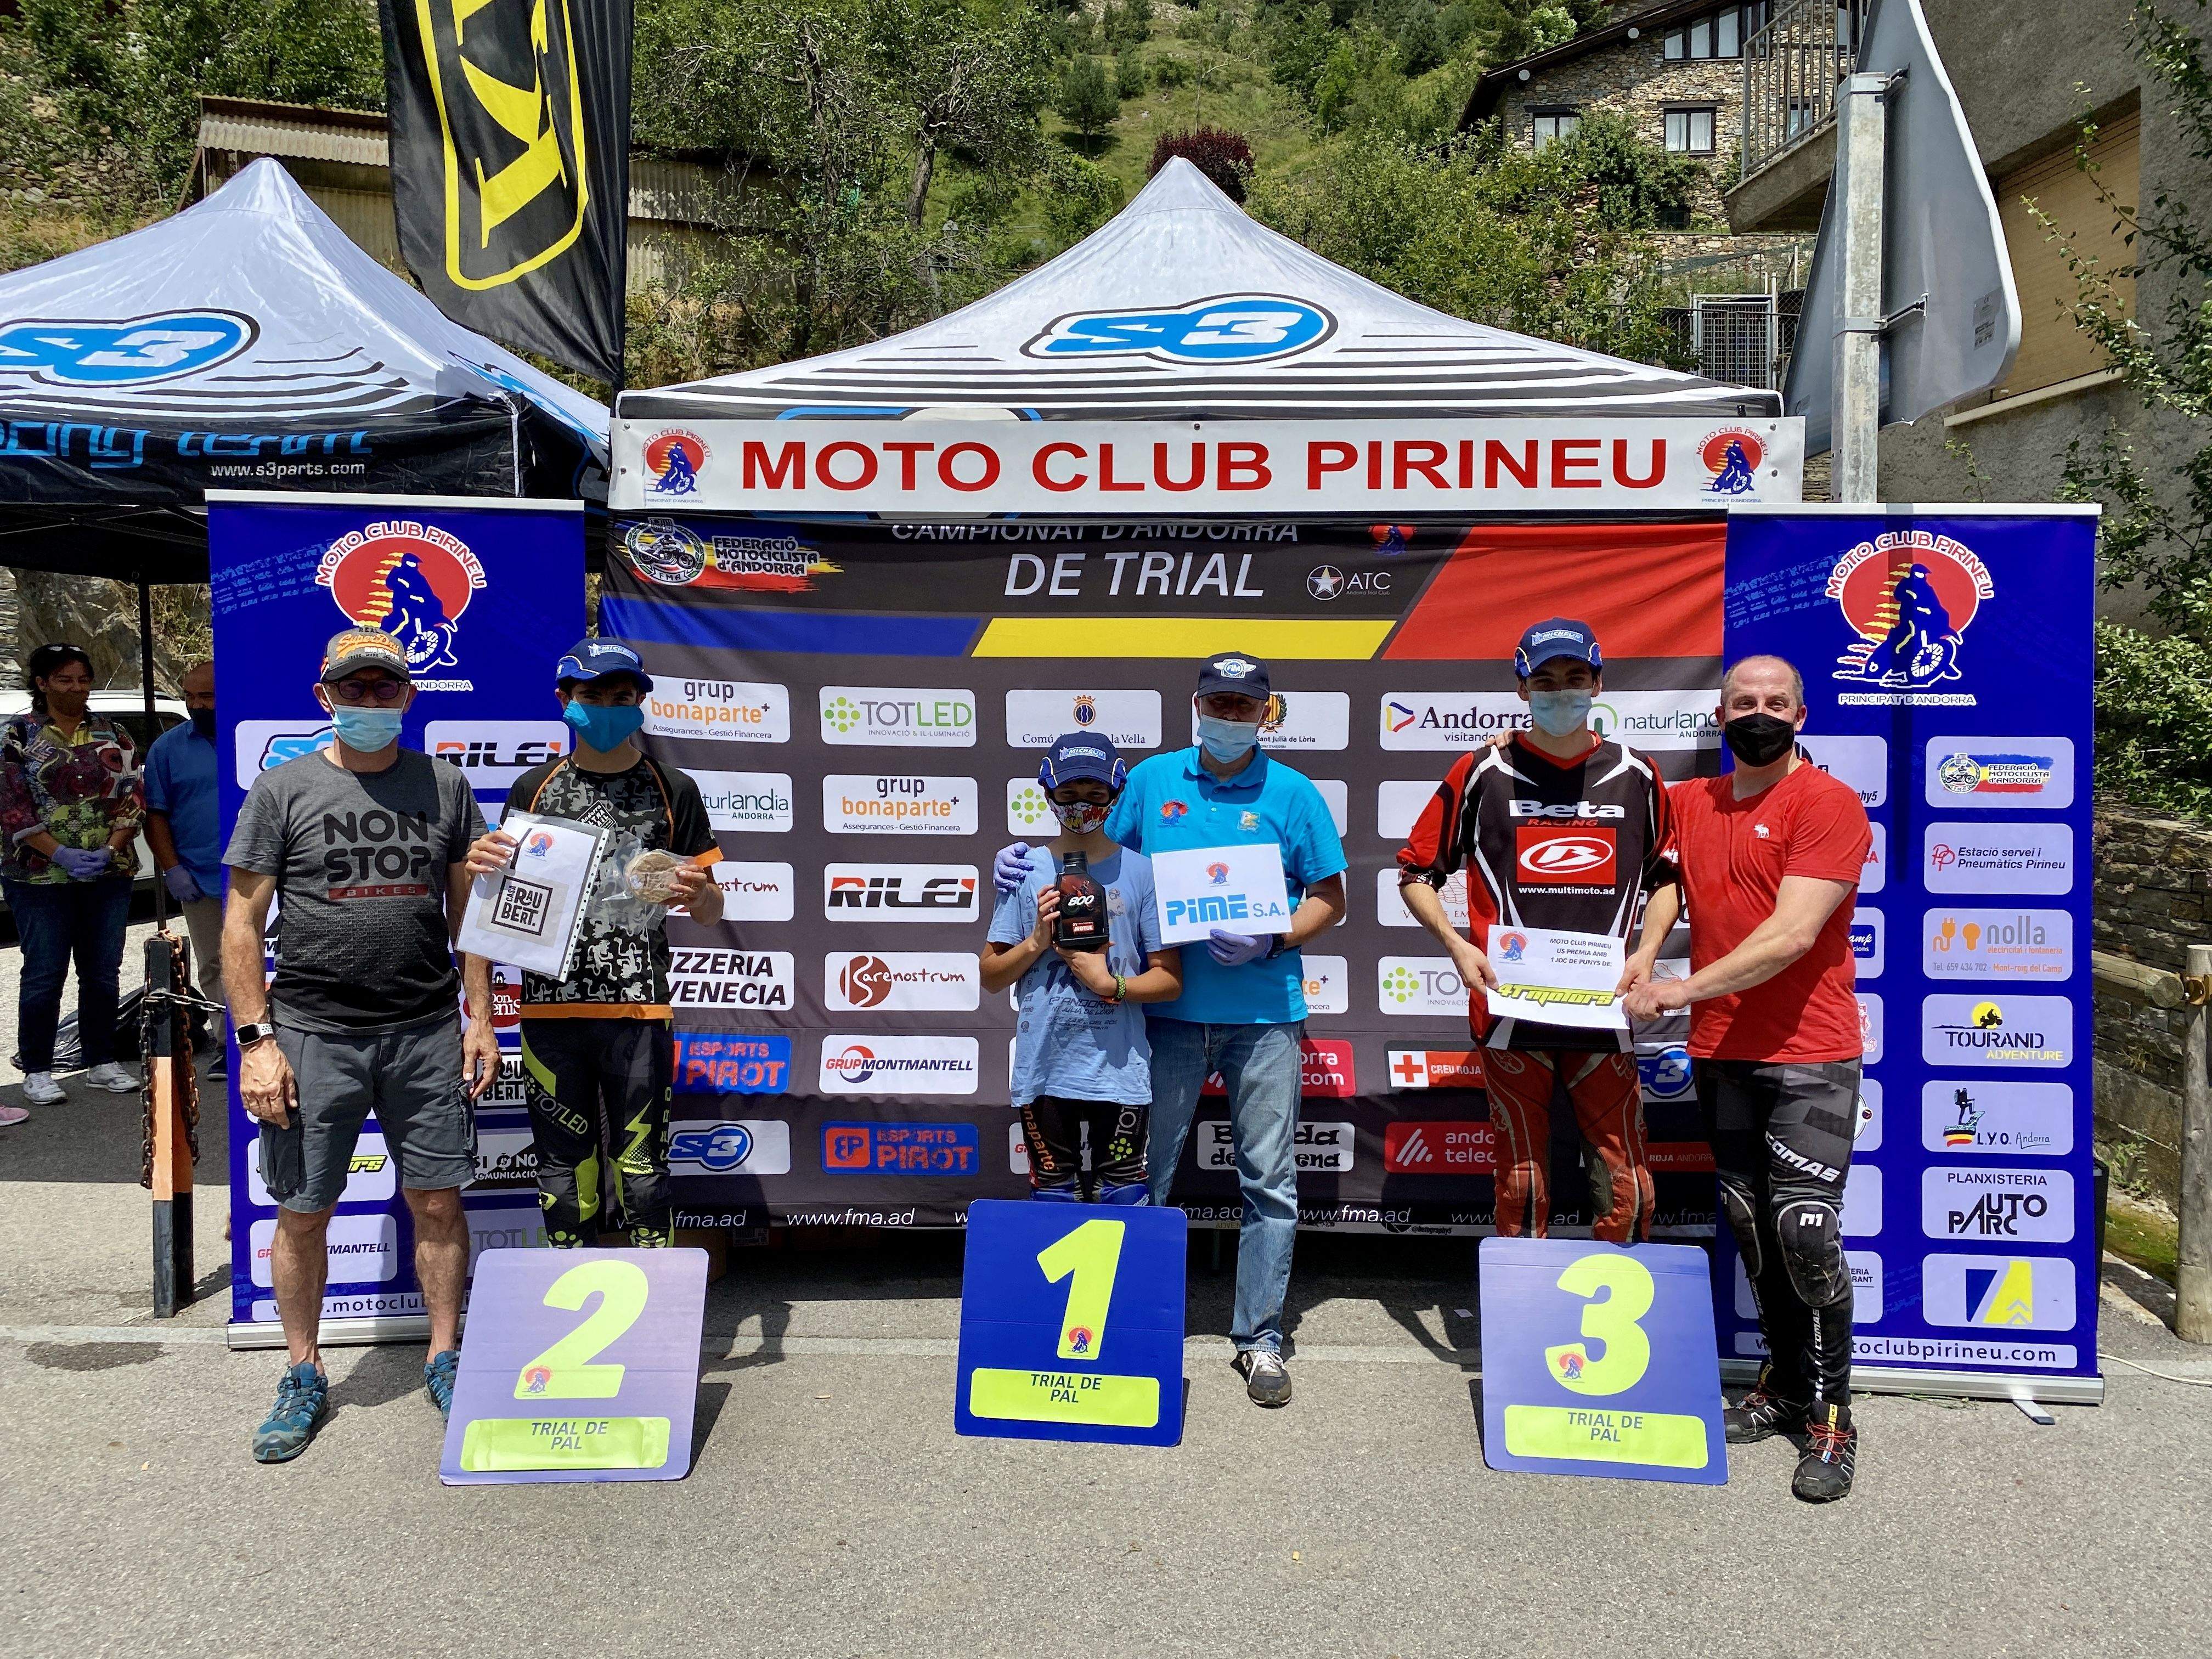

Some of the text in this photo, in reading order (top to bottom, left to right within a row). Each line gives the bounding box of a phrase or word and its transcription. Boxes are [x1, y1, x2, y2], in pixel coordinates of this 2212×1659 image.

[686, 431, 711, 458] PIRINEU
[1696, 431, 1716, 455] MOTO
[1745, 428, 1769, 456] PIRINEU
[212, 462, 365, 479] www.s3parts.com
[743, 438, 1667, 492] MOTO CLUB PIRINEU
[714, 537, 797, 550] FEDERACIÓ
[318, 523, 486, 588] MOTO CLUB PIRINEU
[715, 549, 818, 563] MOTOCICLISTA
[717, 560, 806, 575] d'ANDORRA
[1827, 532, 1993, 597] MOTO CLUB PIRINEU
[1004, 551, 1264, 597] DE TRIAL
[1346, 572, 1391, 590] ATC
[684, 681, 734, 703] grup
[1840, 695, 1974, 704] PRINCIPAT D'ANDORRA
[860, 702, 972, 727] TOTLED
[1419, 706, 1534, 729] Andorra
[652, 724, 772, 739] Assegurances Gestió Financera
[868, 729, 910, 737] INNOVACIÓ
[1023, 733, 1054, 744] Comú
[1111, 734, 1120, 744] la
[1121, 734, 1146, 744] Vella
[1444, 732, 1495, 742] visitando
[1989, 763, 2037, 771] FEDERACIÓ
[877, 777, 925, 798] grup
[732, 812, 774, 820] ANDORRA
[1509, 799, 1625, 818] Beta
[323, 810, 428, 845] NON
[842, 822, 961, 832] Assegurances Gestió Financera
[1958, 846, 1999, 857] Estació
[2001, 847, 2035, 857] servei
[324, 845, 432, 883] STOP
[1957, 858, 2066, 870] Pneumàtics Pirineu
[346, 887, 416, 897] BIKES
[505, 885, 516, 902] CASA
[514, 887, 543, 909] RAU
[1518, 886, 1615, 895] www.multimoto.ad
[1068, 895, 1095, 906] 800
[500, 902, 539, 927] BERT.
[1252, 902, 1286, 918] S.A.
[1987, 916, 2045, 945] nolla
[2028, 946, 2063, 955] fontaneria
[1946, 963, 1959, 971] 659
[1960, 963, 1973, 971] 434
[1975, 963, 1988, 972] 702
[1993, 963, 2028, 974] Mont-roig
[2030, 964, 2040, 972] del
[2042, 964, 2063, 974] Camp
[1945, 1031, 2044, 1048] TOURAND
[689, 1042, 770, 1057] ESPORTS
[1986, 1049, 2064, 1062] ADVENTURE
[686, 1059, 786, 1087] PIROT
[1430, 1064, 1482, 1075] CREU ROJA
[534, 1088, 588, 1135] TOTLED
[877, 1129, 957, 1143] ESPORTS
[2015, 1132, 2051, 1147] Andorra
[516, 1153, 538, 1167] NO
[877, 1145, 974, 1170] PIROT
[1649, 1154, 1674, 1162] ROJA
[1765, 1131, 1841, 1182] COMAS
[473, 1169, 538, 1180] COMUNICACIÓ
[1948, 1172, 2047, 1186] PLANXISTERIA
[786, 1207, 916, 1227] www.fma.ad
[1036, 1219, 1126, 1360] 1
[515, 1260, 649, 1400] 2
[1545, 1254, 1655, 1396] 3
[1030, 1373, 1103, 1390] TRIAL DE
[1050, 1390, 1079, 1403] PAL
[1567, 1412, 1644, 1429] TRIAL DE
[531, 1421, 609, 1436] TRIAL DE
[1590, 1428, 1621, 1442] PAL
[550, 1436, 583, 1450] PAL
